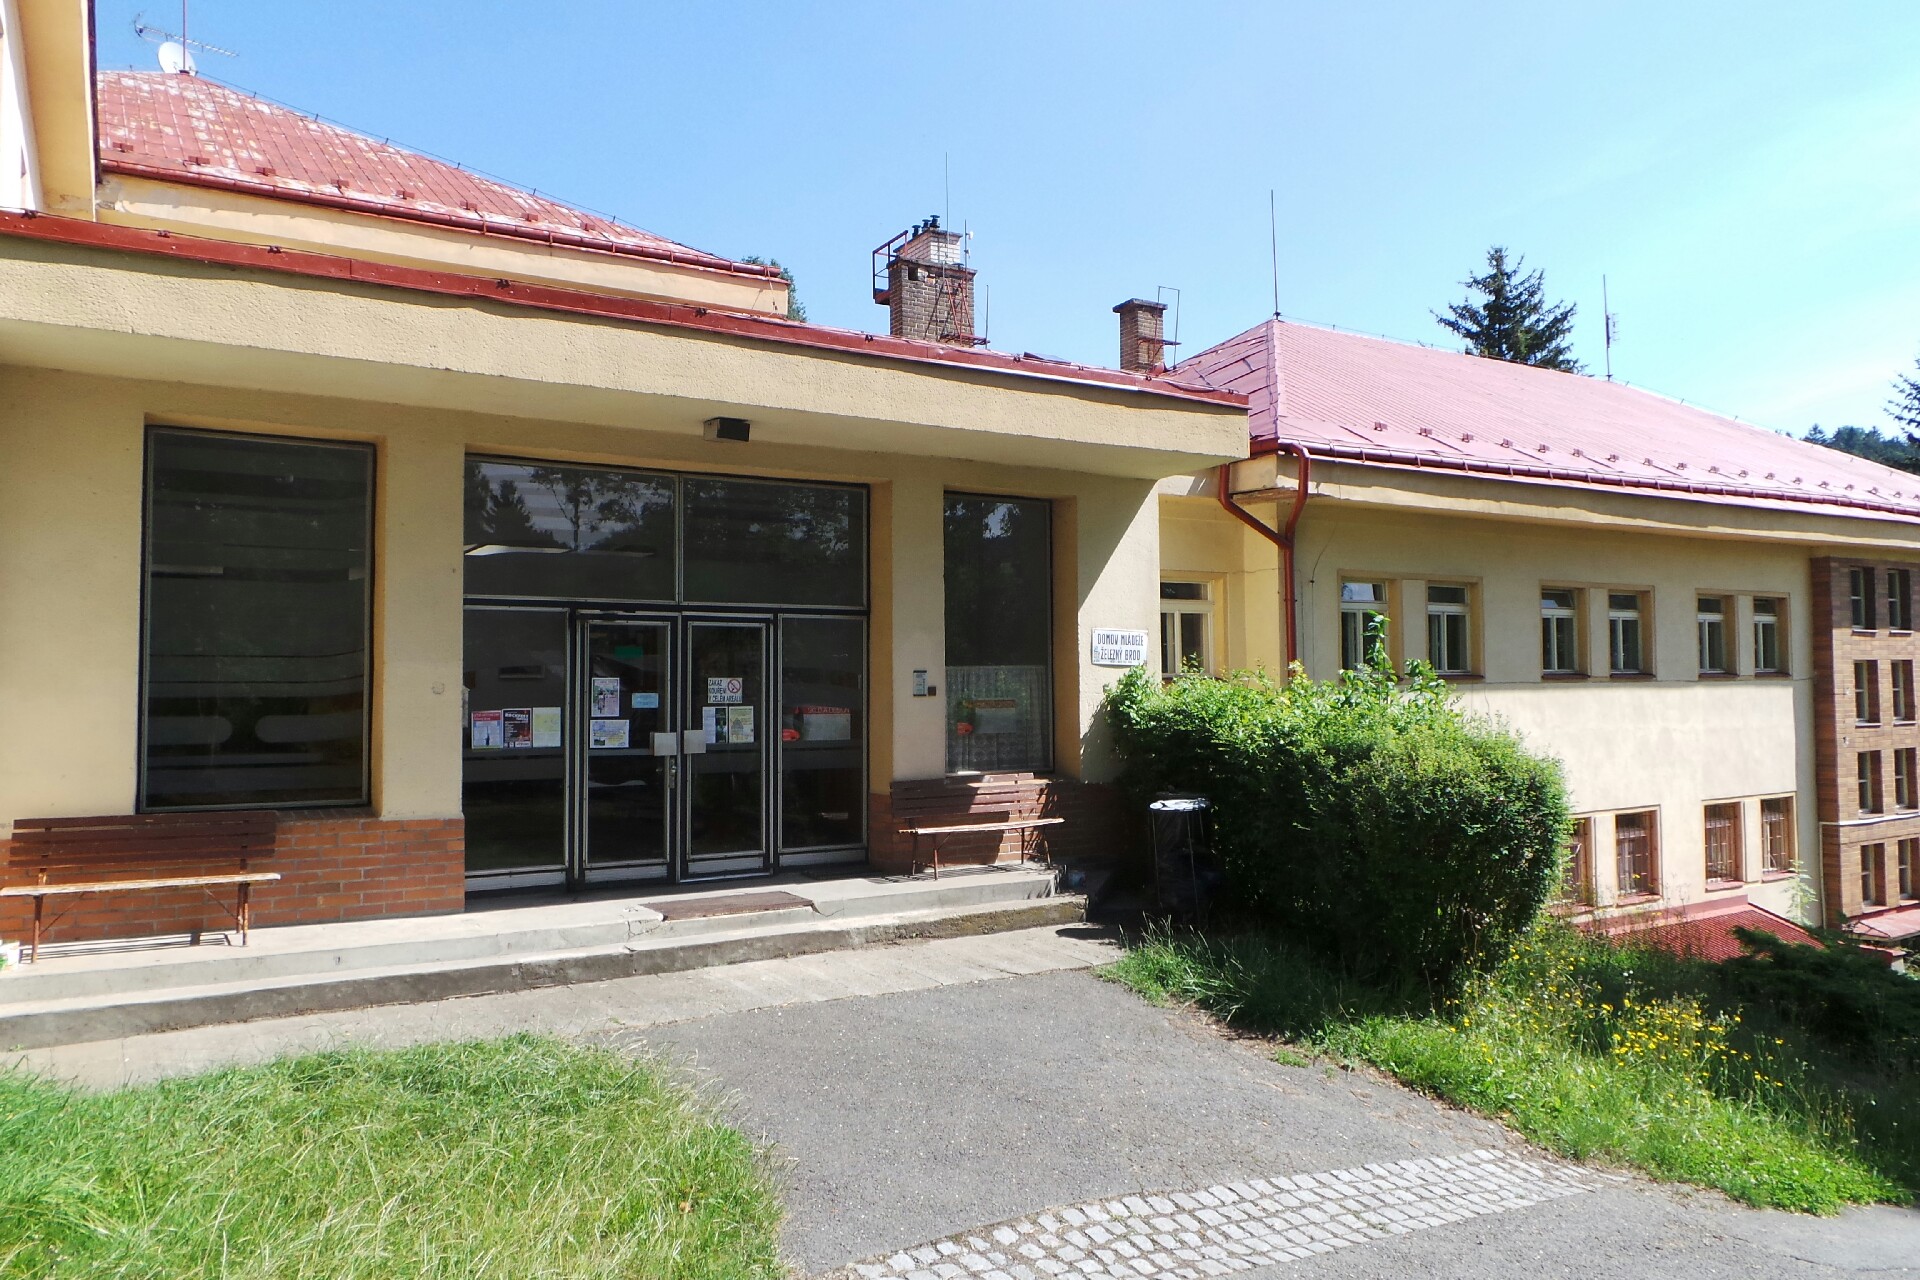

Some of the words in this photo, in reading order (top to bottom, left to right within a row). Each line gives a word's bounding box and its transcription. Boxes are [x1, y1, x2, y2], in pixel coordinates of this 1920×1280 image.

[1098, 633, 1118, 645] DOMOV
[1121, 633, 1143, 646] MLÁDEŽE
[1100, 647, 1122, 660] ŽELEZNÝ
[1125, 650, 1140, 660] BROD
